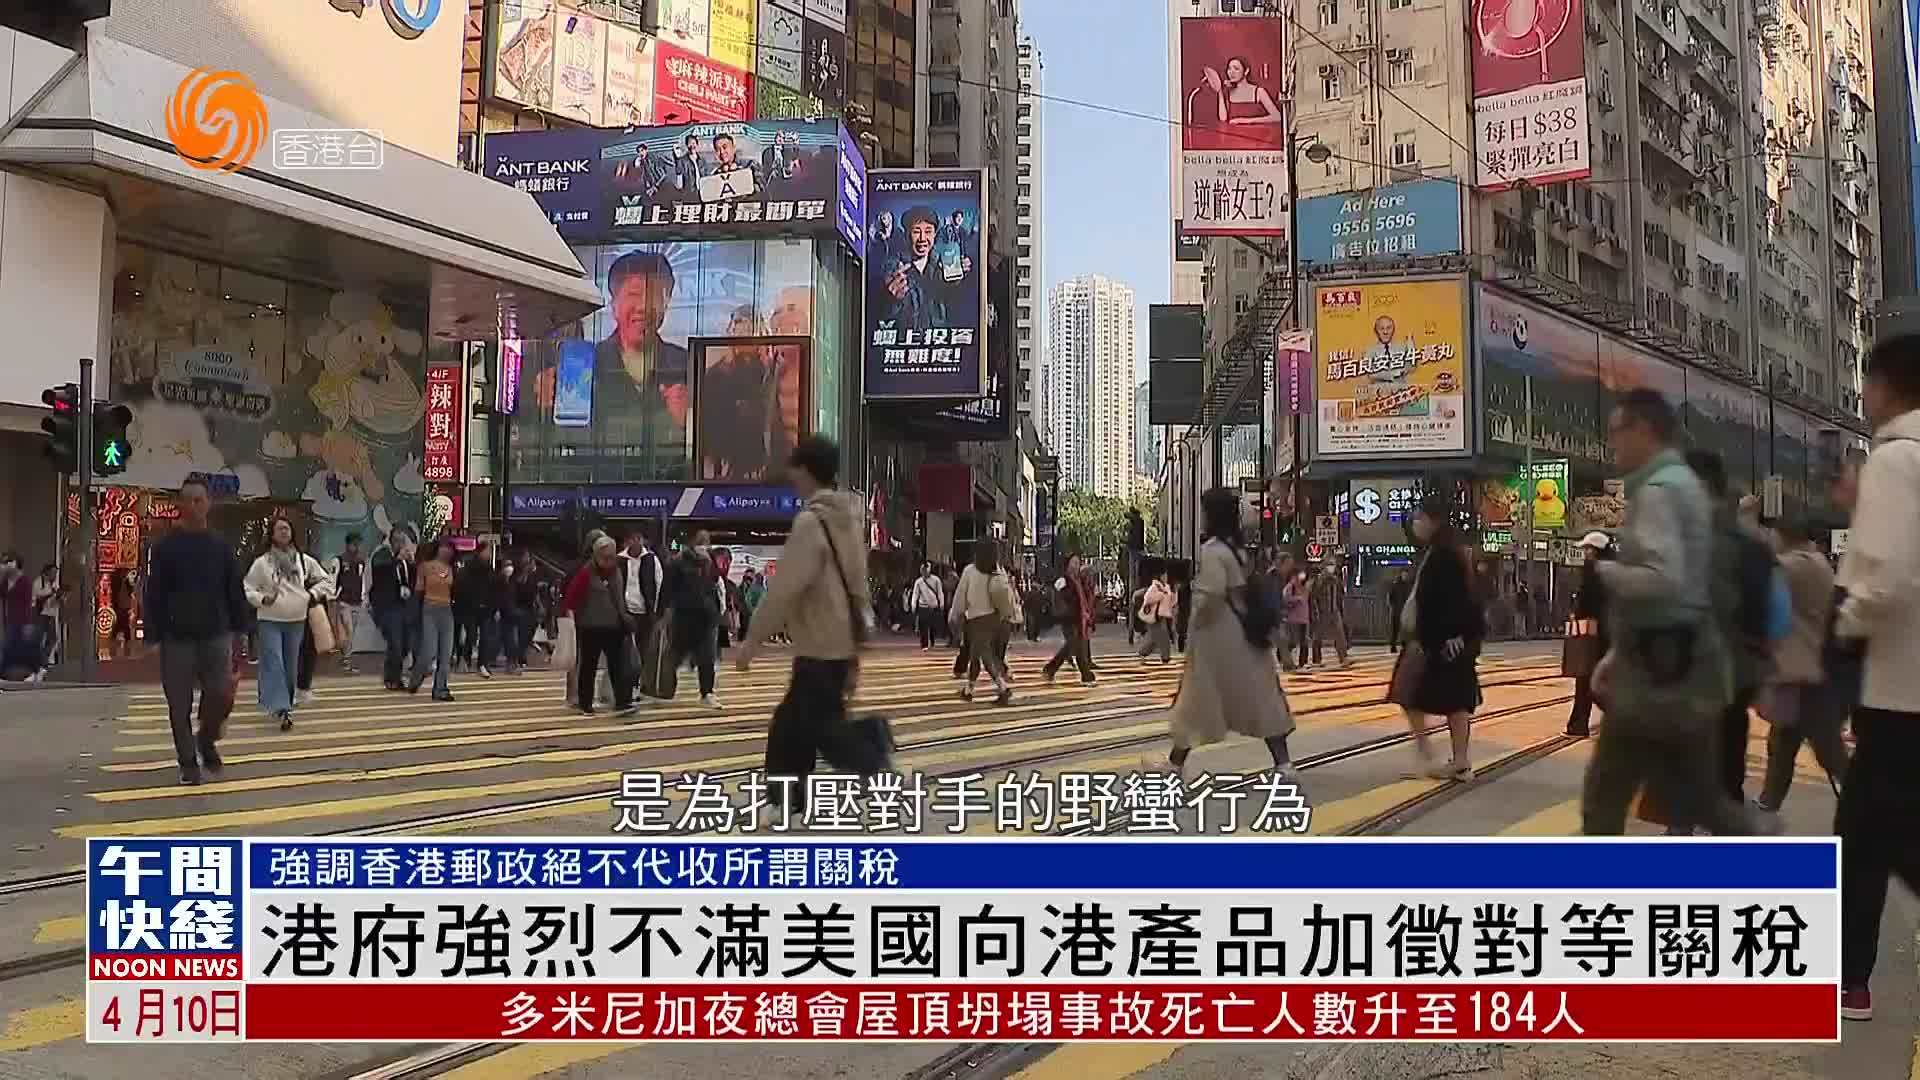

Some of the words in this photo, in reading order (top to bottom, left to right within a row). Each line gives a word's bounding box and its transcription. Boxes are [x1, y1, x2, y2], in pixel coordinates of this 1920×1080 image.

[1486, 138, 1579, 175] 緊彈亮白
[537, 160, 590, 176] BANK
[901, 181, 933, 191] BANK
[1194, 178, 1275, 221] 逆齡女王?
[1340, 197, 1363, 214] Ad
[1367, 194, 1406, 210] Here
[1332, 218, 1370, 237] 9556
[1375, 212, 1417, 231] 5696
[1331, 233, 1417, 261] 廣告位招租
[424, 467, 453, 478] 4898
